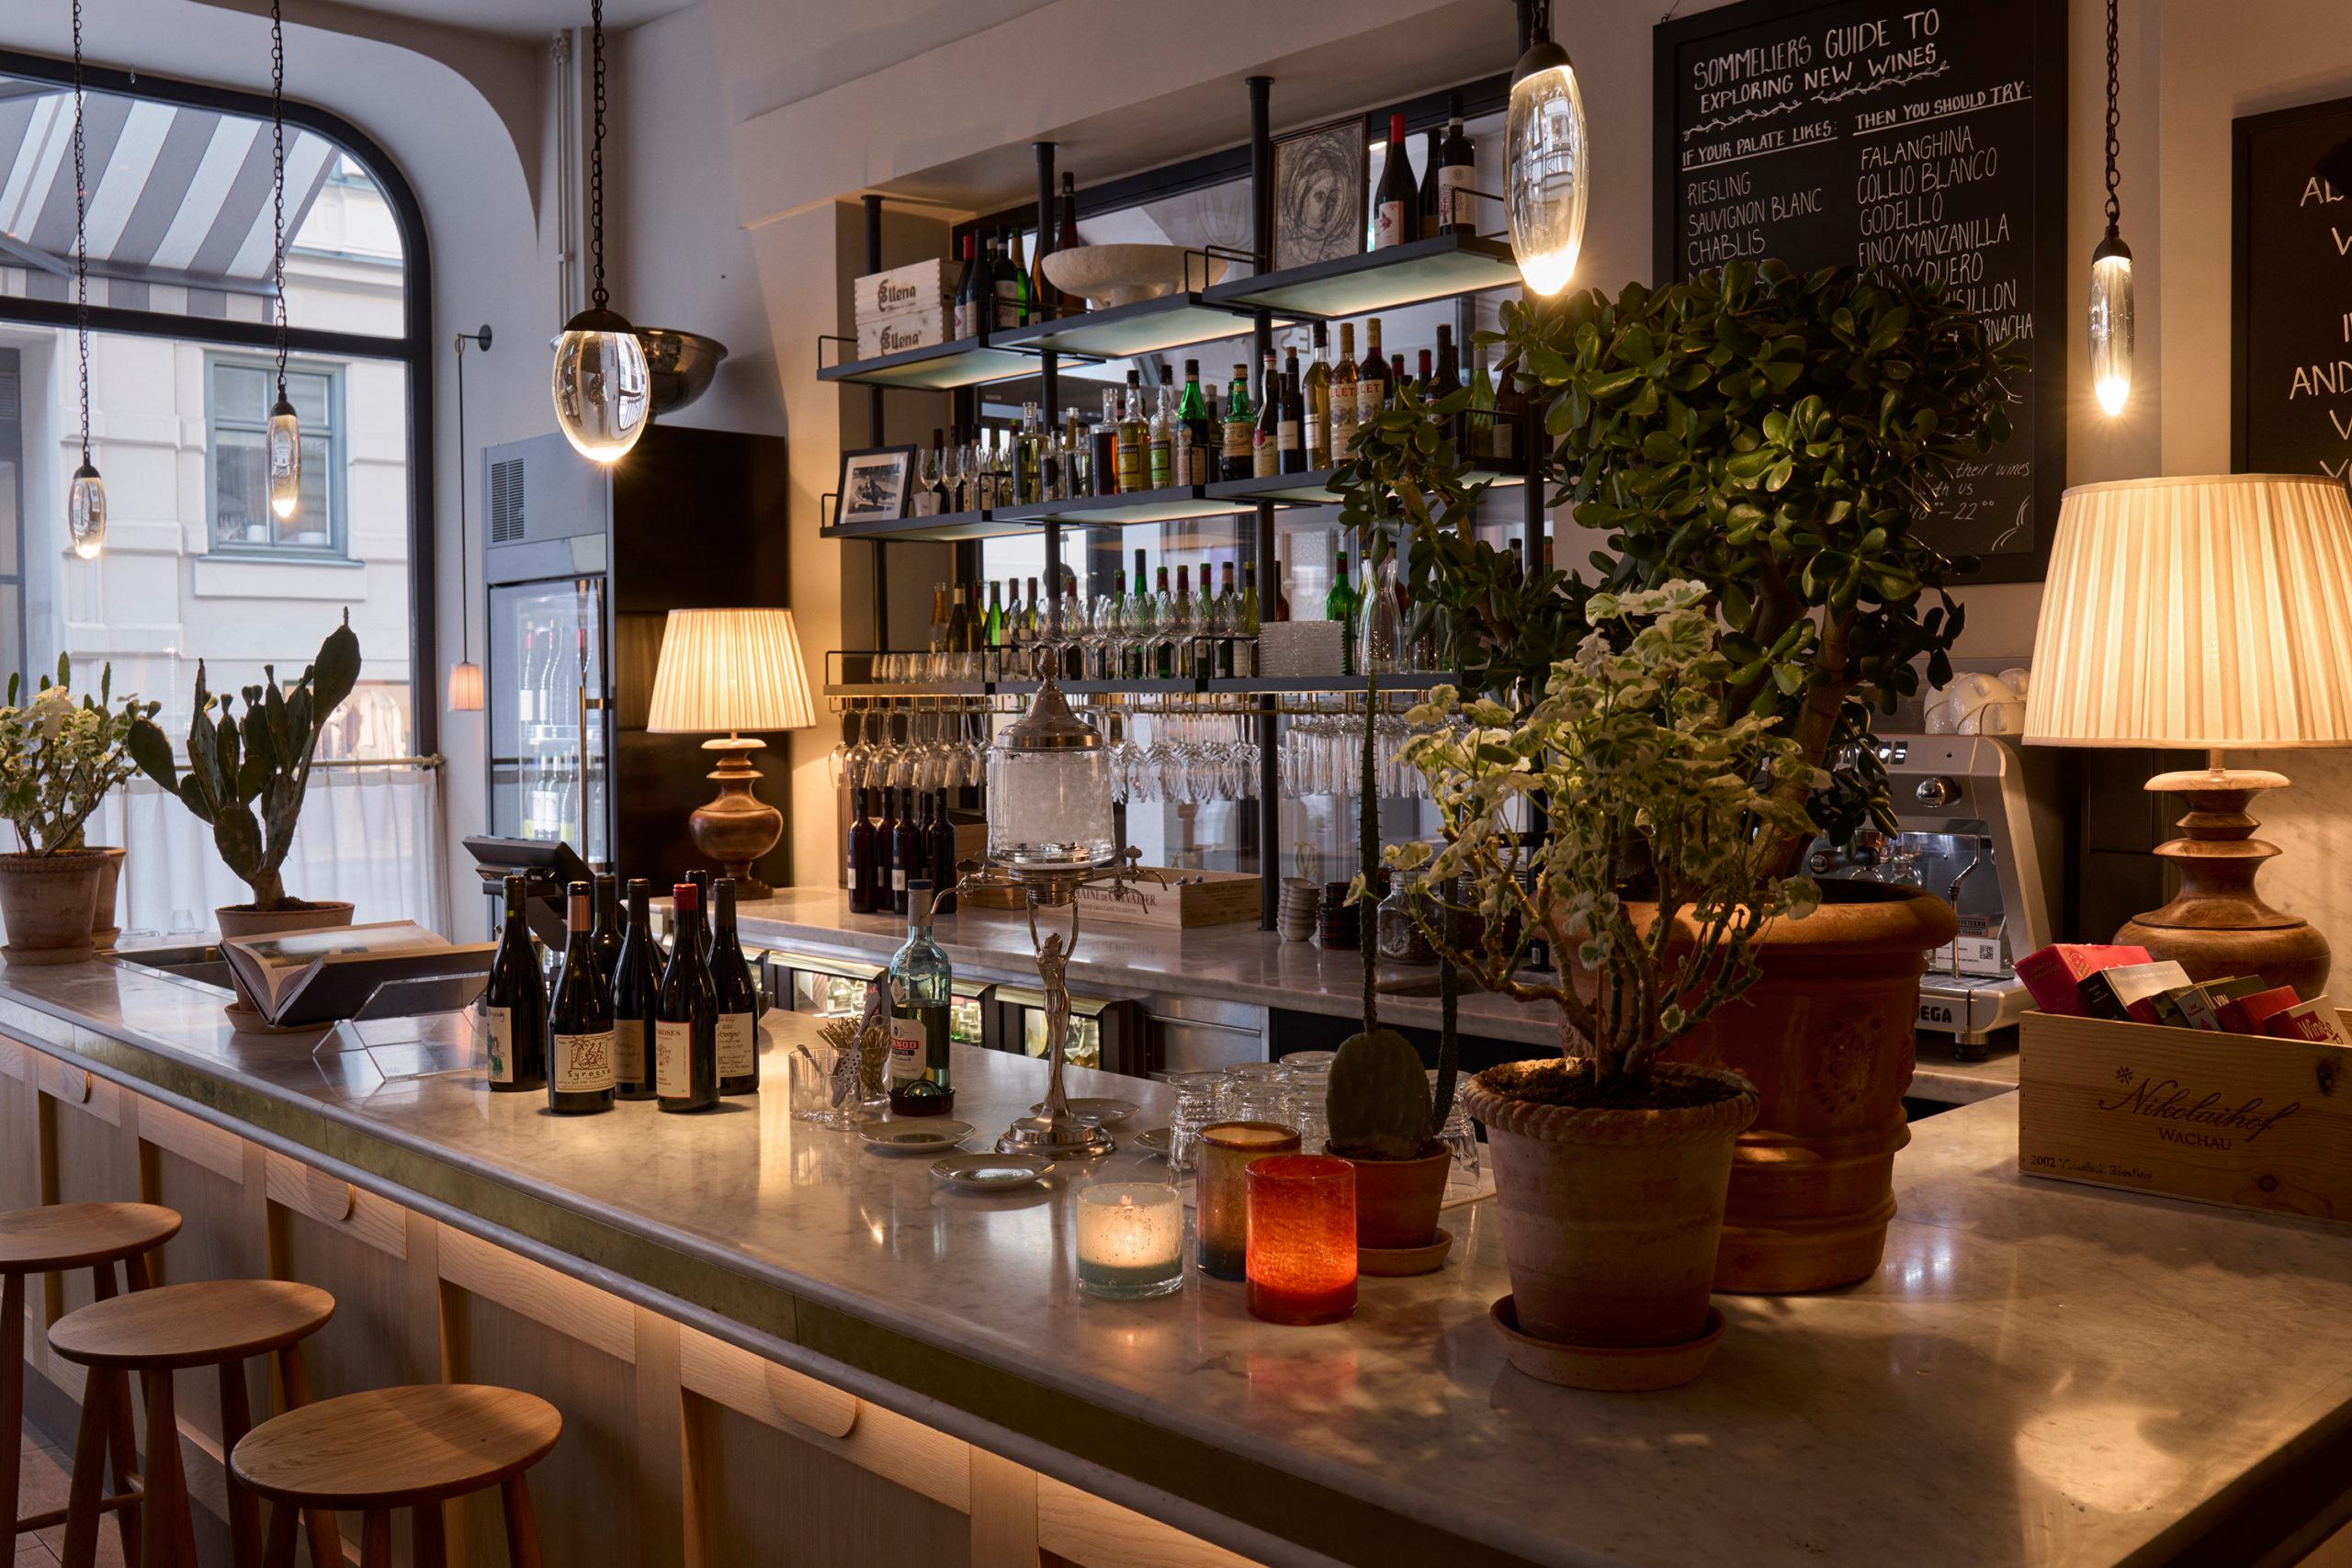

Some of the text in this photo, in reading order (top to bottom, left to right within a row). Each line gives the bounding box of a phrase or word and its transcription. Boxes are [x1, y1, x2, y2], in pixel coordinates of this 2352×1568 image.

[1693, 7, 1940, 91] SOMMELIERS GUIDE TO
[1701, 42, 1937, 114] EXPLORING NEW WINES
[1854, 108, 1896, 130] THEN
[1903, 101, 1929, 121] YOU
[1933, 91, 1985, 115] SHOULD
[1682, 149, 1695, 167] IF
[1699, 141, 1732, 164] YOUR
[1736, 130, 1786, 155] PALATE
[1861, 125, 1973, 170] FALANGHINA
[1688, 172, 1751, 206] RIESLING
[1858, 146, 1997, 204] COLLIO BLANCO
[1687, 187, 1823, 237] SAUVIGNON BLANC
[1860, 192, 1943, 236] GODELLO
[1688, 229, 1766, 266] CHABLIS
[1858, 212, 2010, 267] FINO/MANZANILLA
[1955, 461, 2030, 479] their wines
[1958, 482, 1973, 496] us
[1920, 1005, 1952, 1023] EGA
[2297, 1018, 2334, 1042] Wines
[2098, 1077, 2301, 1144] Nikolaihof
[2158, 1126, 2233, 1150] WACHAU
